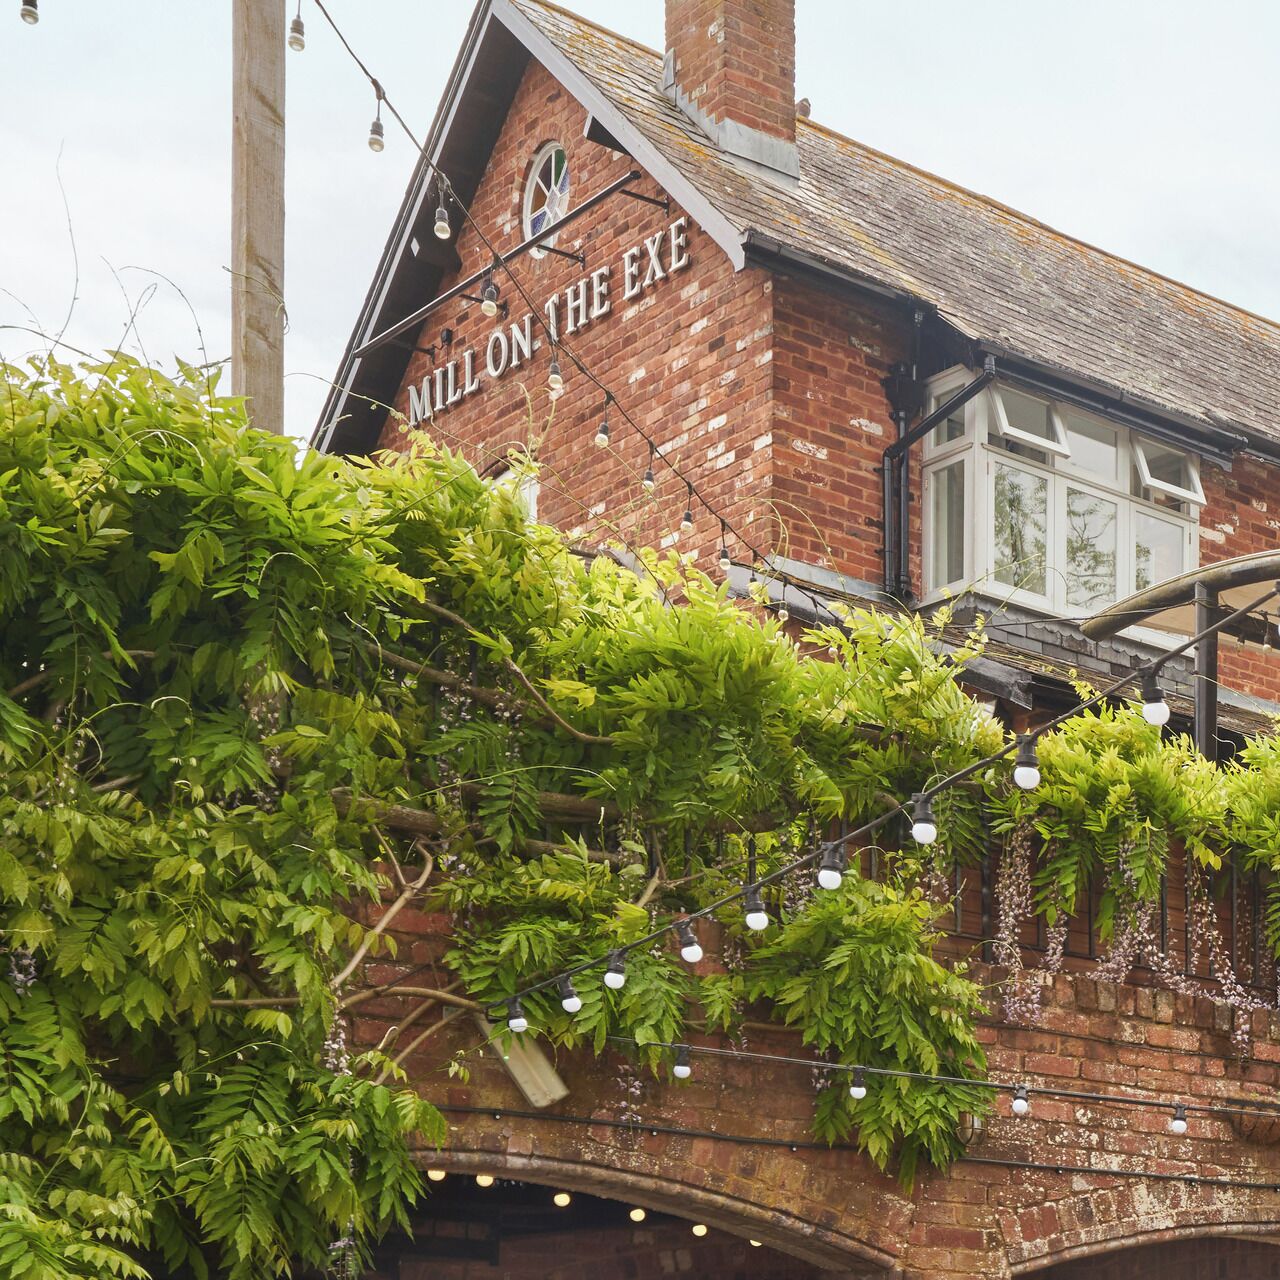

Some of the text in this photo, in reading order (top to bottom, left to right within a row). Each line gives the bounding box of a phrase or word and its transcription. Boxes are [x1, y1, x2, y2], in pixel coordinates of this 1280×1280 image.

[408, 216, 690, 427] MILL ON THE EXE
